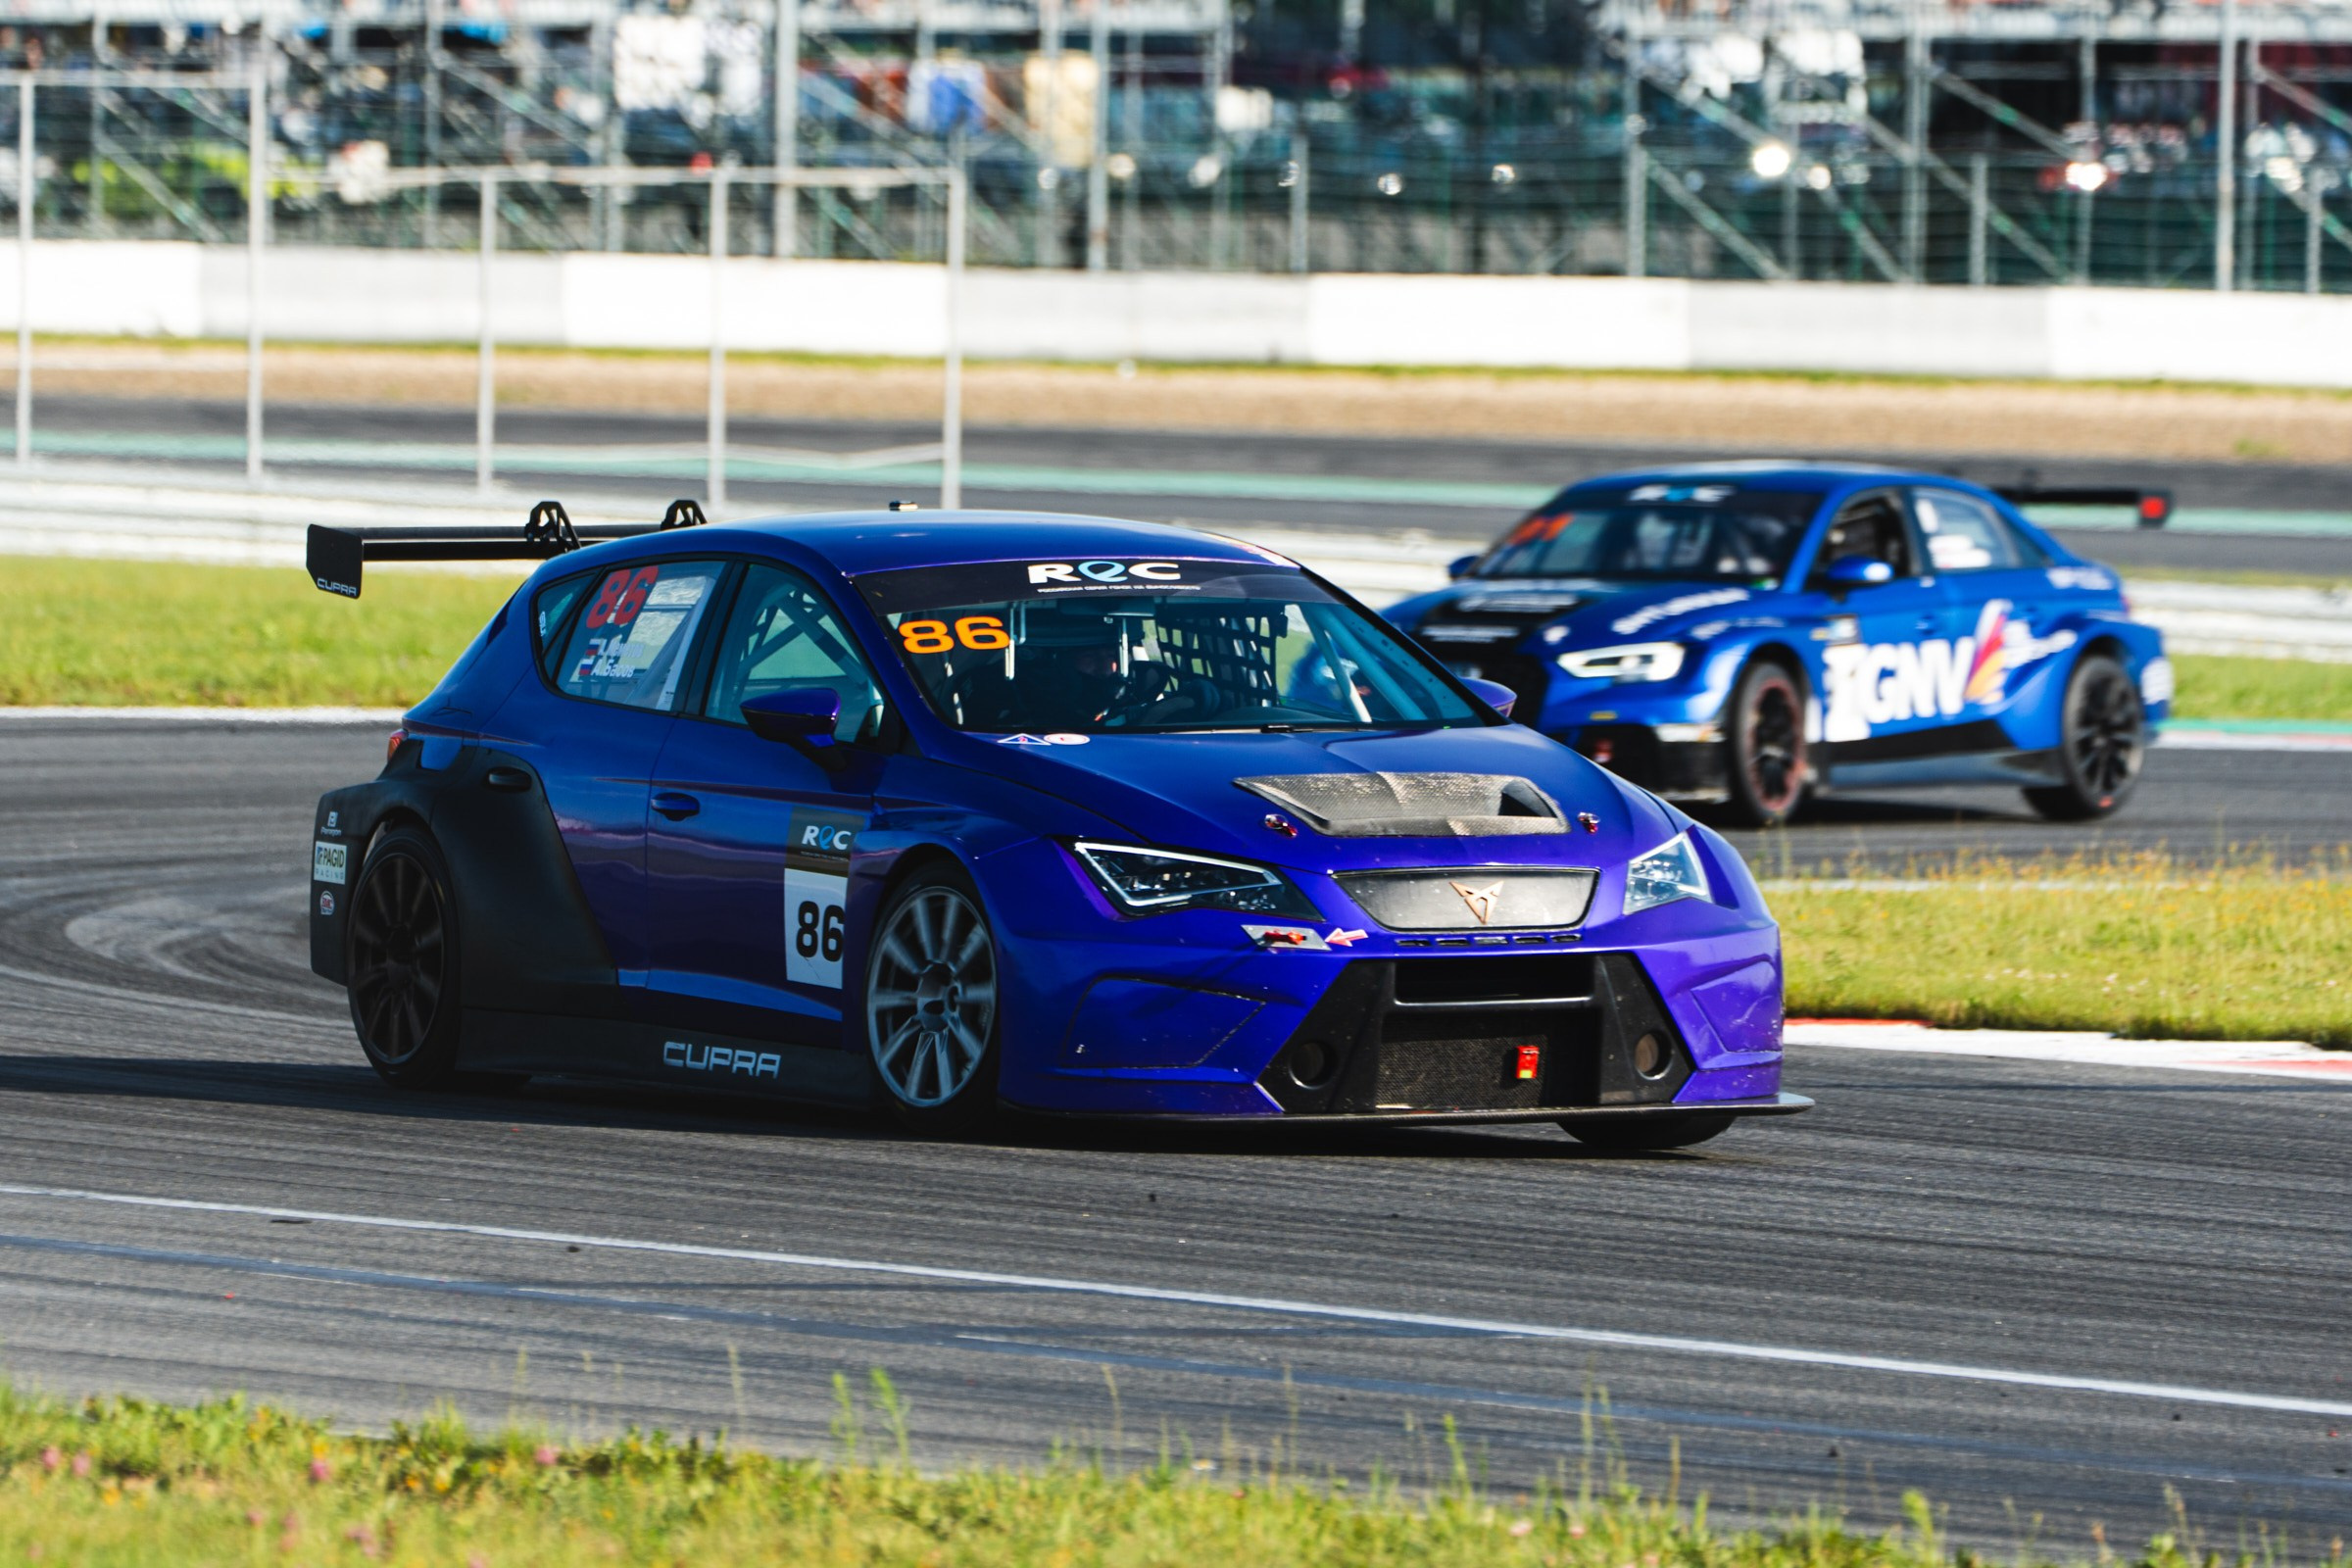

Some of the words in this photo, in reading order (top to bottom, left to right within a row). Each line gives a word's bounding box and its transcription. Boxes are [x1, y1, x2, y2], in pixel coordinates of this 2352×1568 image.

[317, 578, 357, 597] CUPRA
[586, 565, 660, 629] 86
[898, 615, 1010, 654] 86
[322, 847, 345, 868] PAGID
[796, 901, 845, 962] 86
[663, 1041, 782, 1078] CUPRA
